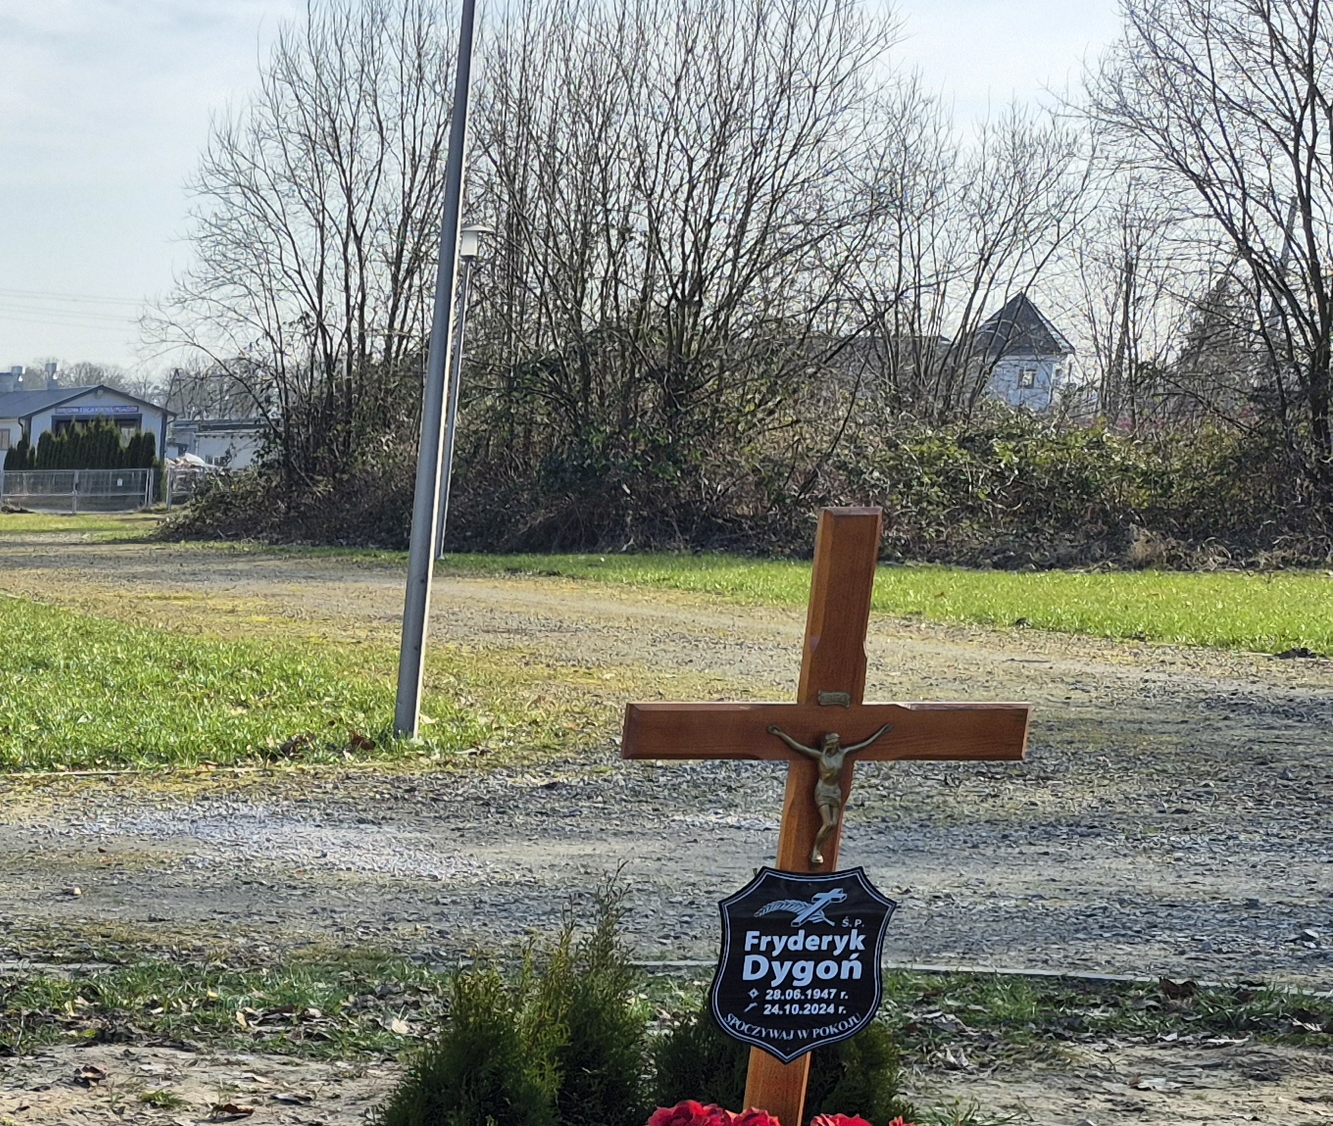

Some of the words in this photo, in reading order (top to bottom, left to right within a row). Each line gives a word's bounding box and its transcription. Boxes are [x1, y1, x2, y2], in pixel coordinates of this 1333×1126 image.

[744, 929, 866, 957] Fryderyk
[742, 953, 863, 988] Dygoń
[765, 989, 837, 1000] 28.06.1947
[840, 991, 848, 999] r.
[763, 1003, 834, 1015] 24.10.2024
[838, 1006, 846, 1014] r.
[724, 1012, 794, 1040] SPOCZYWAJ
[797, 1029, 809, 1040] W
[811, 1012, 863, 1039] POKOJU
